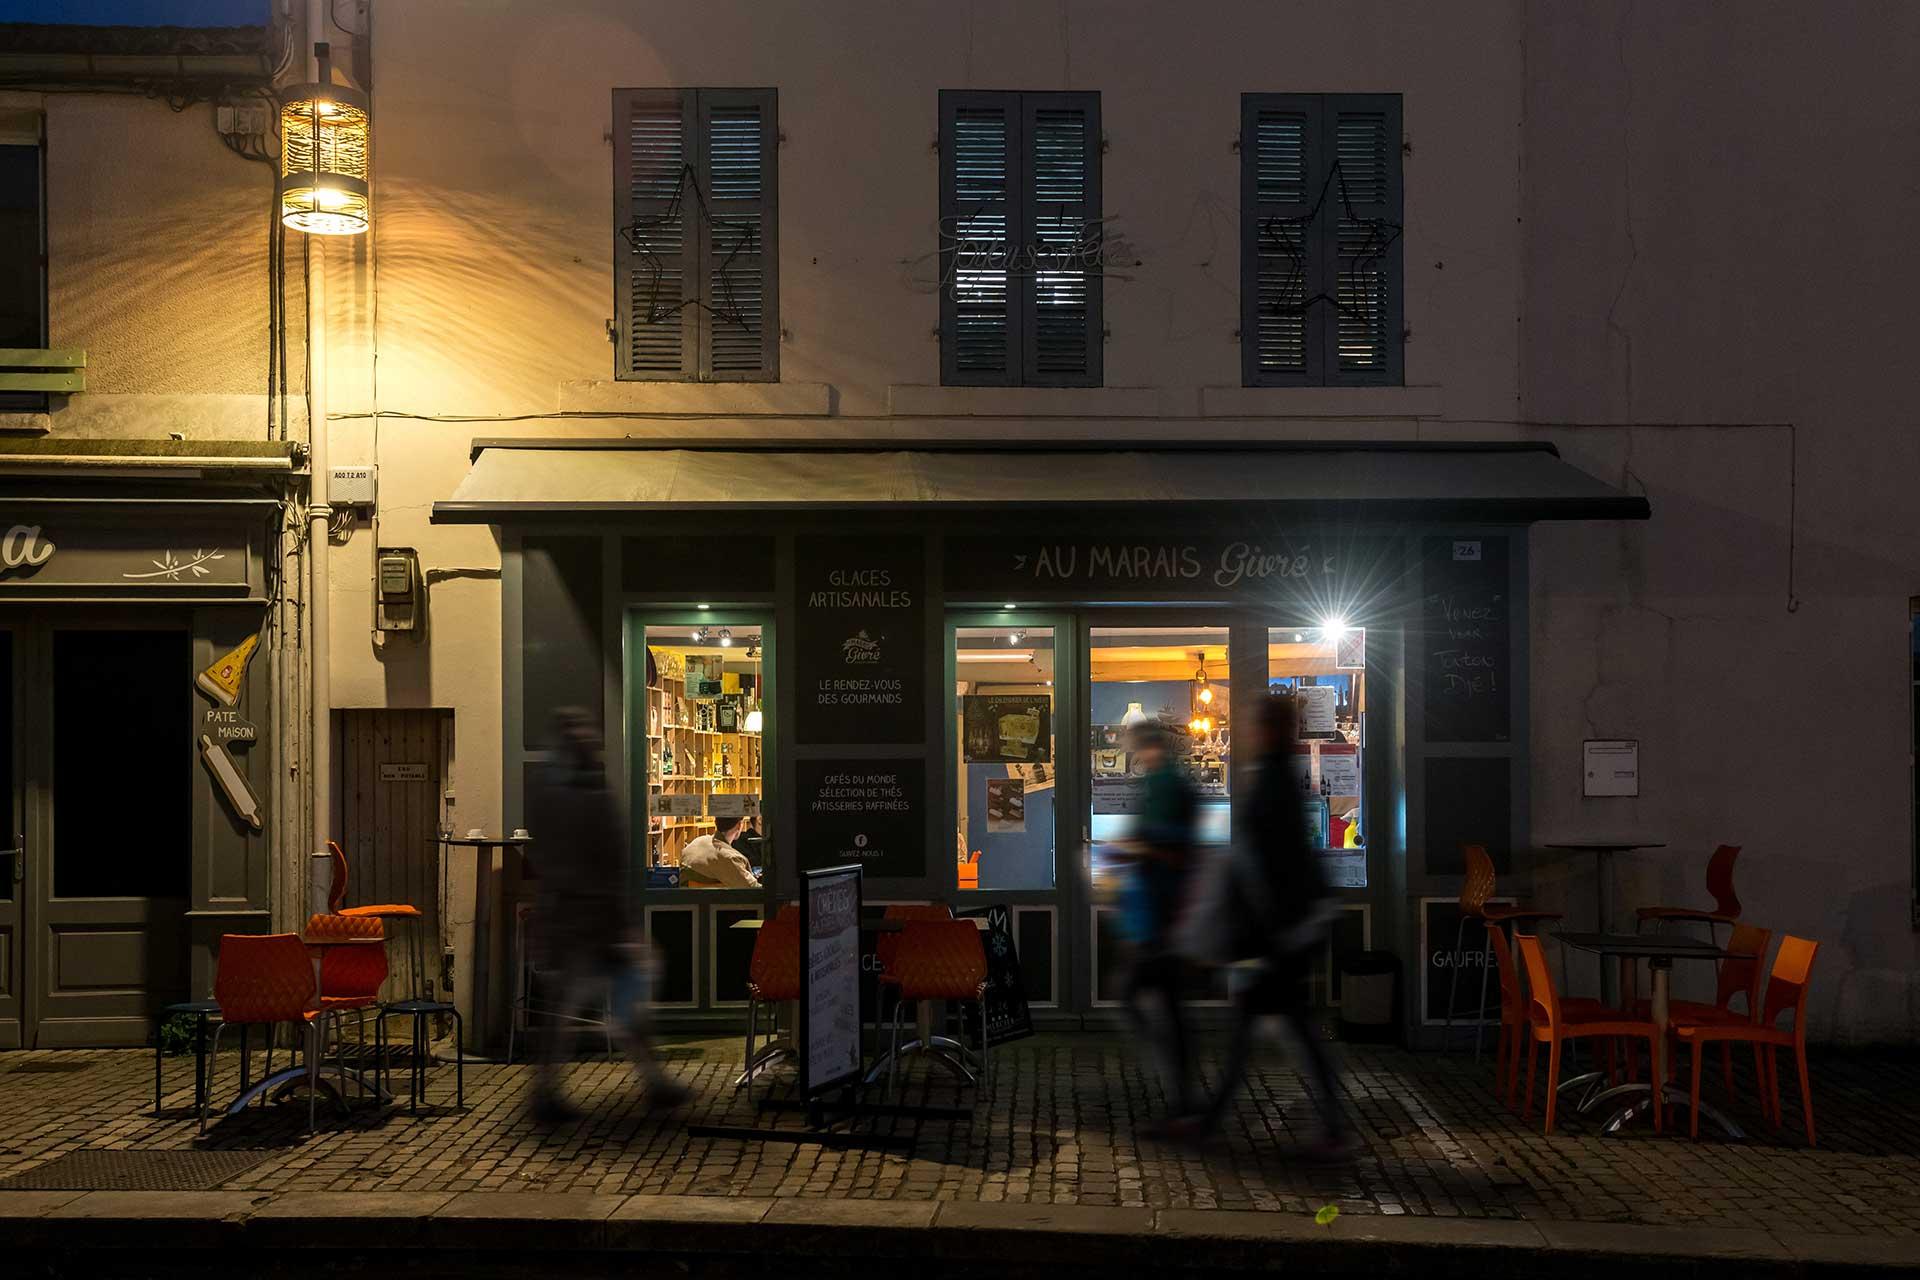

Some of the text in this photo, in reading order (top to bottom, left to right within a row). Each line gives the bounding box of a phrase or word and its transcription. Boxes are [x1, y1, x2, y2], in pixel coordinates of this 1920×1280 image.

[1458, 545, 1475, 557] 26
[1035, 542, 1310, 588] AU MARAIS Givré
[829, 570, 891, 587] GLACES
[808, 591, 912, 608] ARTISANALES
[819, 679, 902, 691] LE RENDEZ-VOUS
[817, 693, 903, 705] DES GOURMANDS
[218, 727, 254, 738] MAISON
[824, 773, 897, 785] CAFÉS DU MONDE
[819, 786, 866, 798] SÉLECTION
[867, 788, 879, 798] DE
[1432, 951, 1499, 968] GAUFRE
